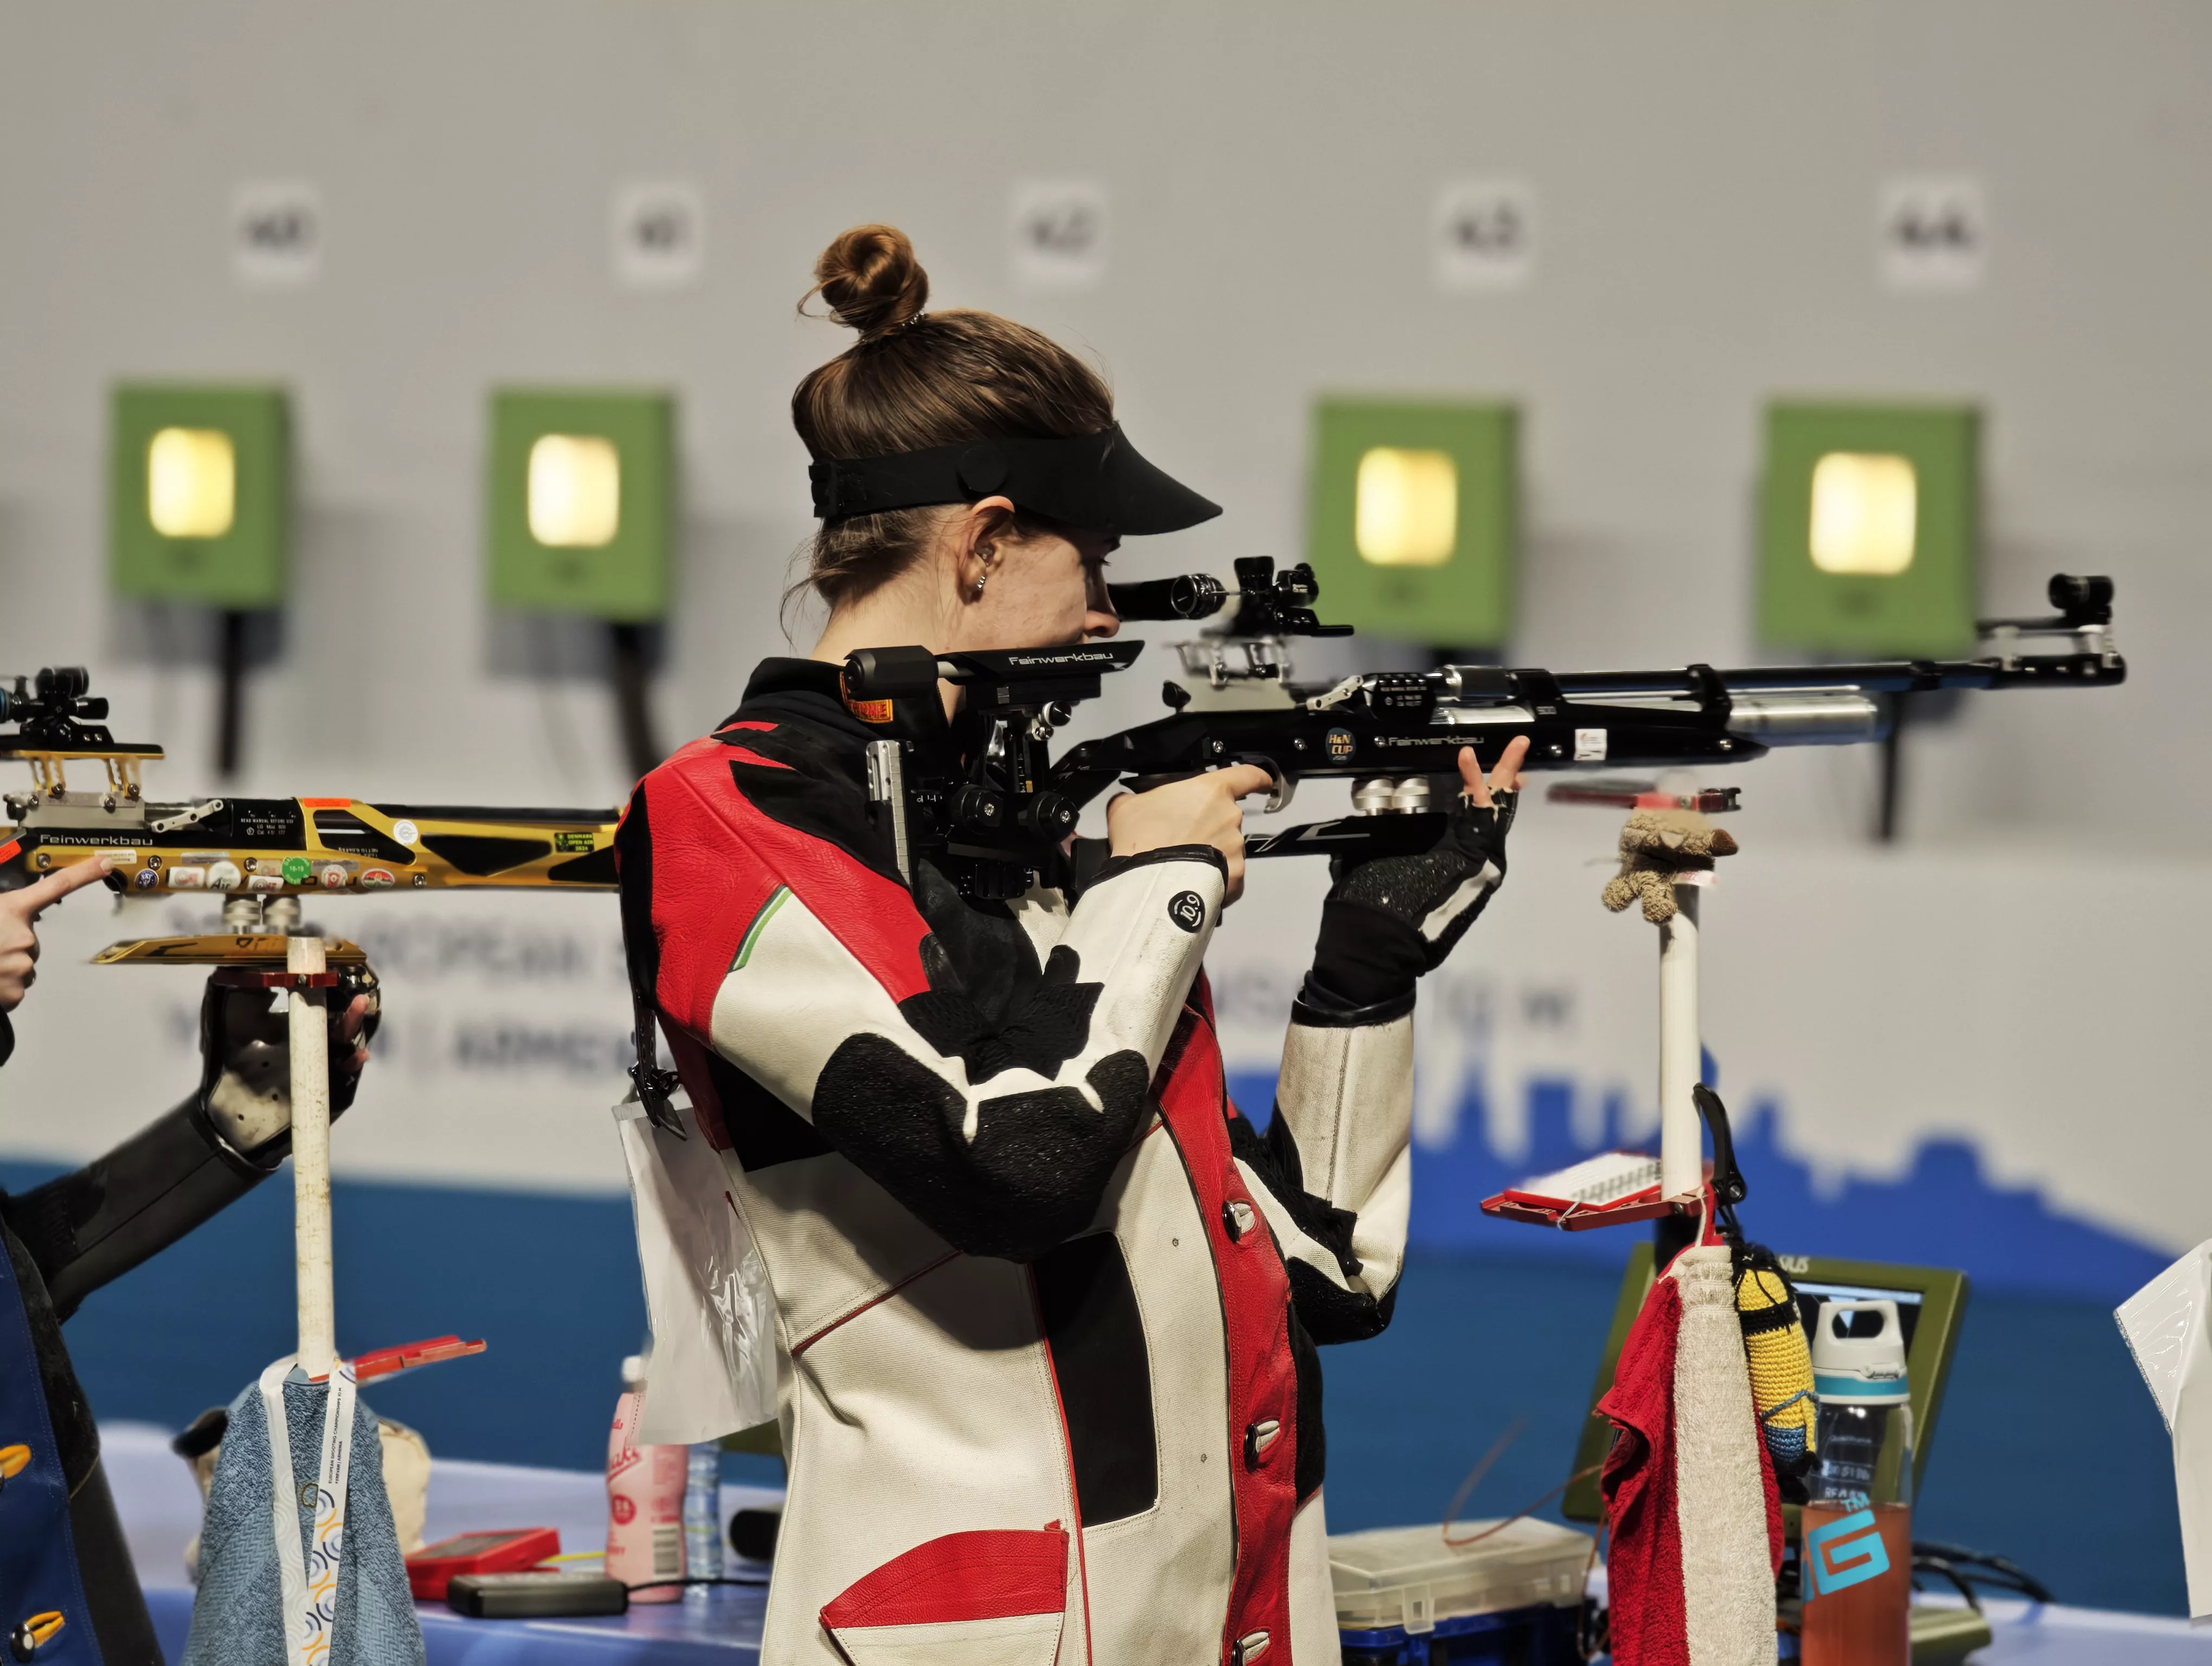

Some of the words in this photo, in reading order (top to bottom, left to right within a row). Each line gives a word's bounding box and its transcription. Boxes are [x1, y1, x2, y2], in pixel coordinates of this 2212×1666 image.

[1008, 652, 1114, 665] Feinwerkbau
[1328, 734, 1351, 744] H&N
[1388, 735, 1484, 747] Feinwerkbau
[1331, 745, 1353, 754] CUP
[40, 834, 153, 846] Feinwerkbau
[210, 876, 231, 890] Air
[1180, 894, 1200, 921] 10.9
